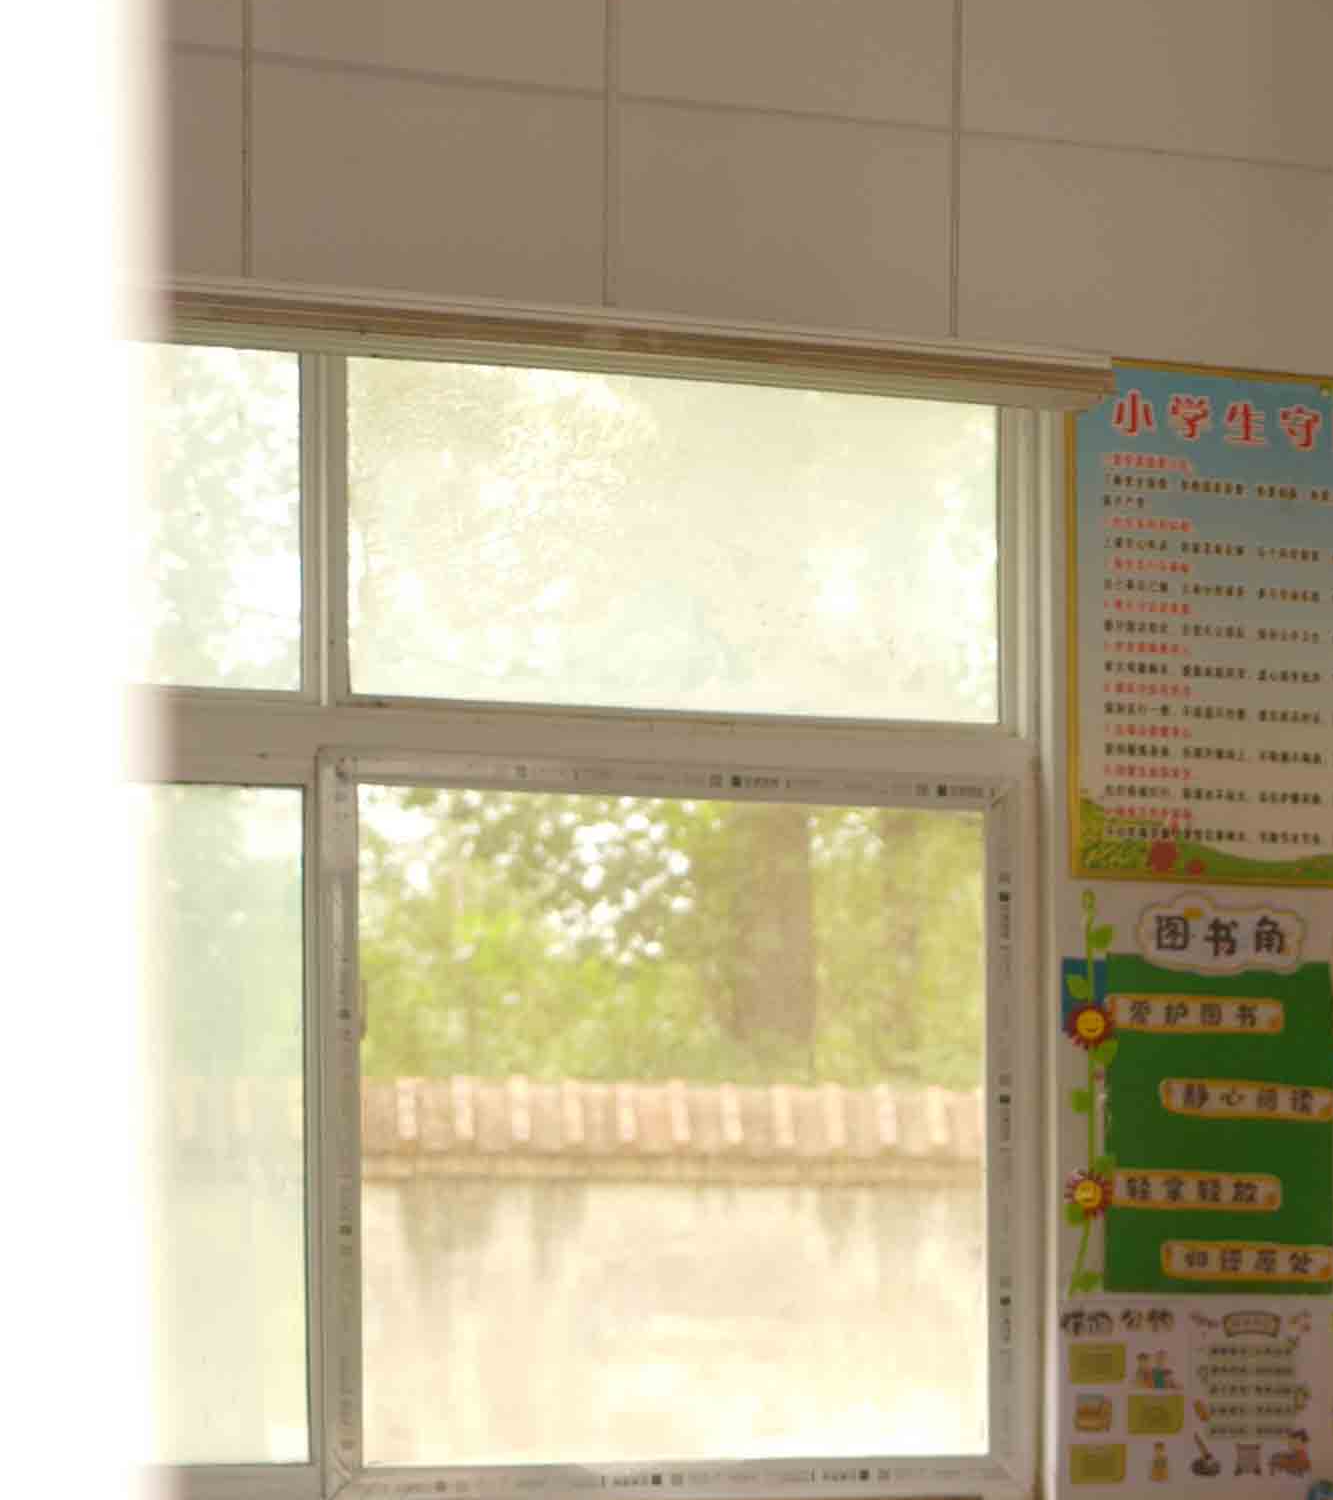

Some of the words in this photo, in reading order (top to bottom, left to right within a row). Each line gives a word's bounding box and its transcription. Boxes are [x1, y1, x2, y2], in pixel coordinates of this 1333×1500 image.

[1155, 915, 1286, 956] 图书角
[1128, 1001, 1260, 1026] 爱护图书
[1183, 1087, 1315, 1114] 静心阅读
[1126, 1177, 1260, 1204] 轻拿轻放
